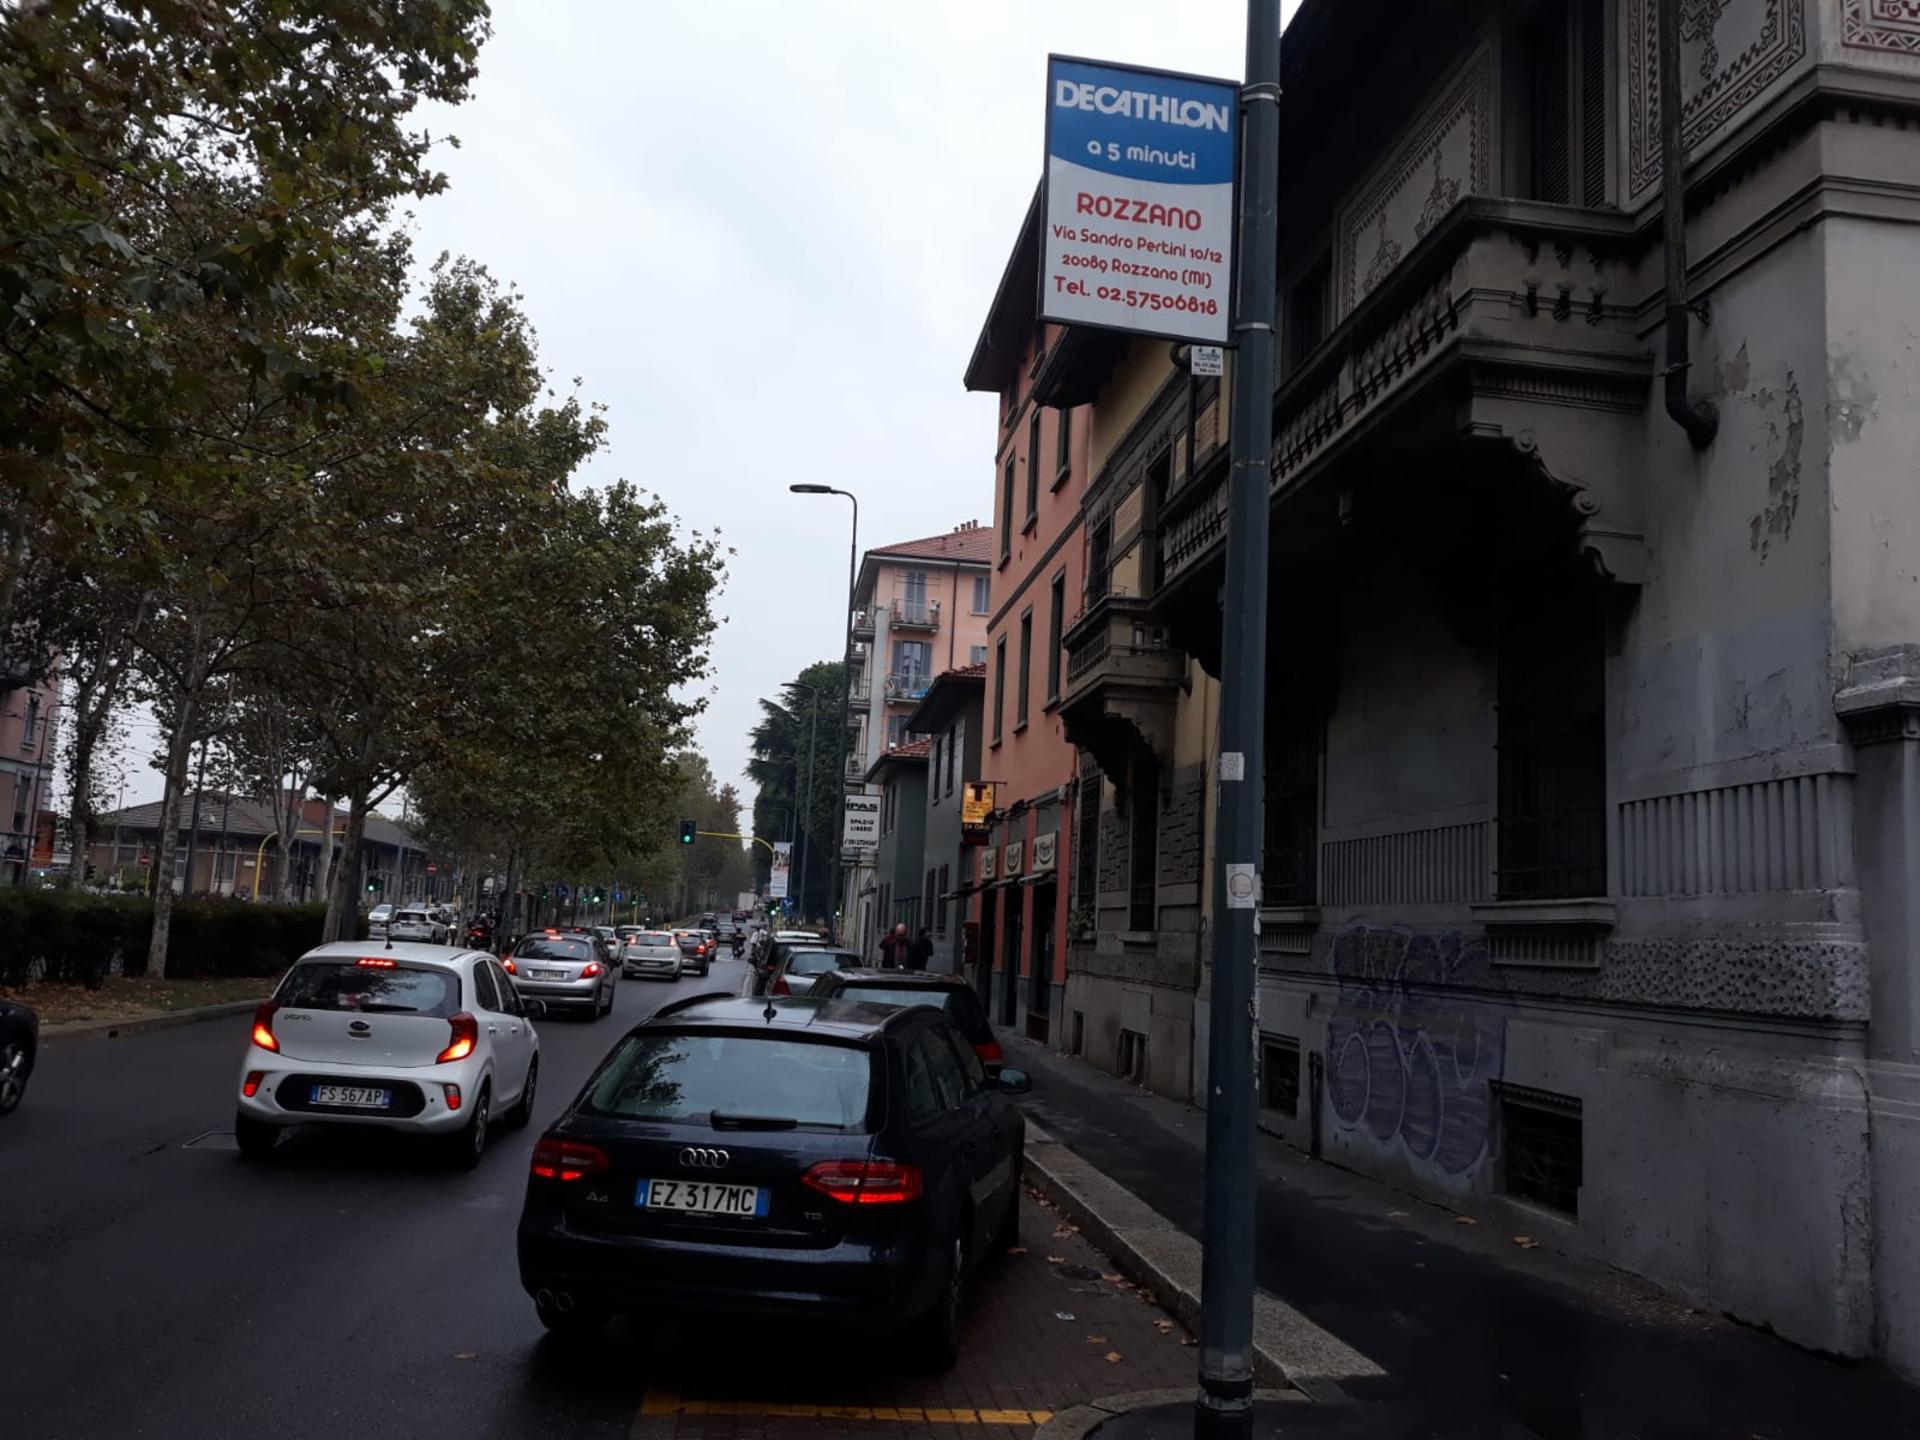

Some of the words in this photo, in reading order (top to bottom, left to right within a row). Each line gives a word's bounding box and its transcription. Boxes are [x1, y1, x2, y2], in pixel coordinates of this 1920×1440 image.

[1056, 80, 1229, 133] DECATHLON
[1087, 140, 1101, 155] a
[1108, 143, 1121, 161] 5
[1127, 145, 1196, 169] minuti
[1077, 192, 1202, 231] ROZZANO
[1053, 224, 1076, 241] Via
[1081, 229, 1133, 249] Sandro
[1137, 237, 1186, 257] Pertini
[1190, 247, 1222, 264] 10/12
[1062, 254, 1108, 273] 20089
[1112, 258, 1178, 281] Rozzano
[1182, 269, 1212, 289] (MI)
[1054, 275, 1090, 297] Tel.
[1097, 286, 1218, 315] 02.57506818
[970, 784, 987, 801] T
[320, 1086, 337, 1101] FS
[340, 1087, 383, 1104] 567AP
[650, 1181, 679, 1206] EZ
[685, 1184, 754, 1212] 317MC
